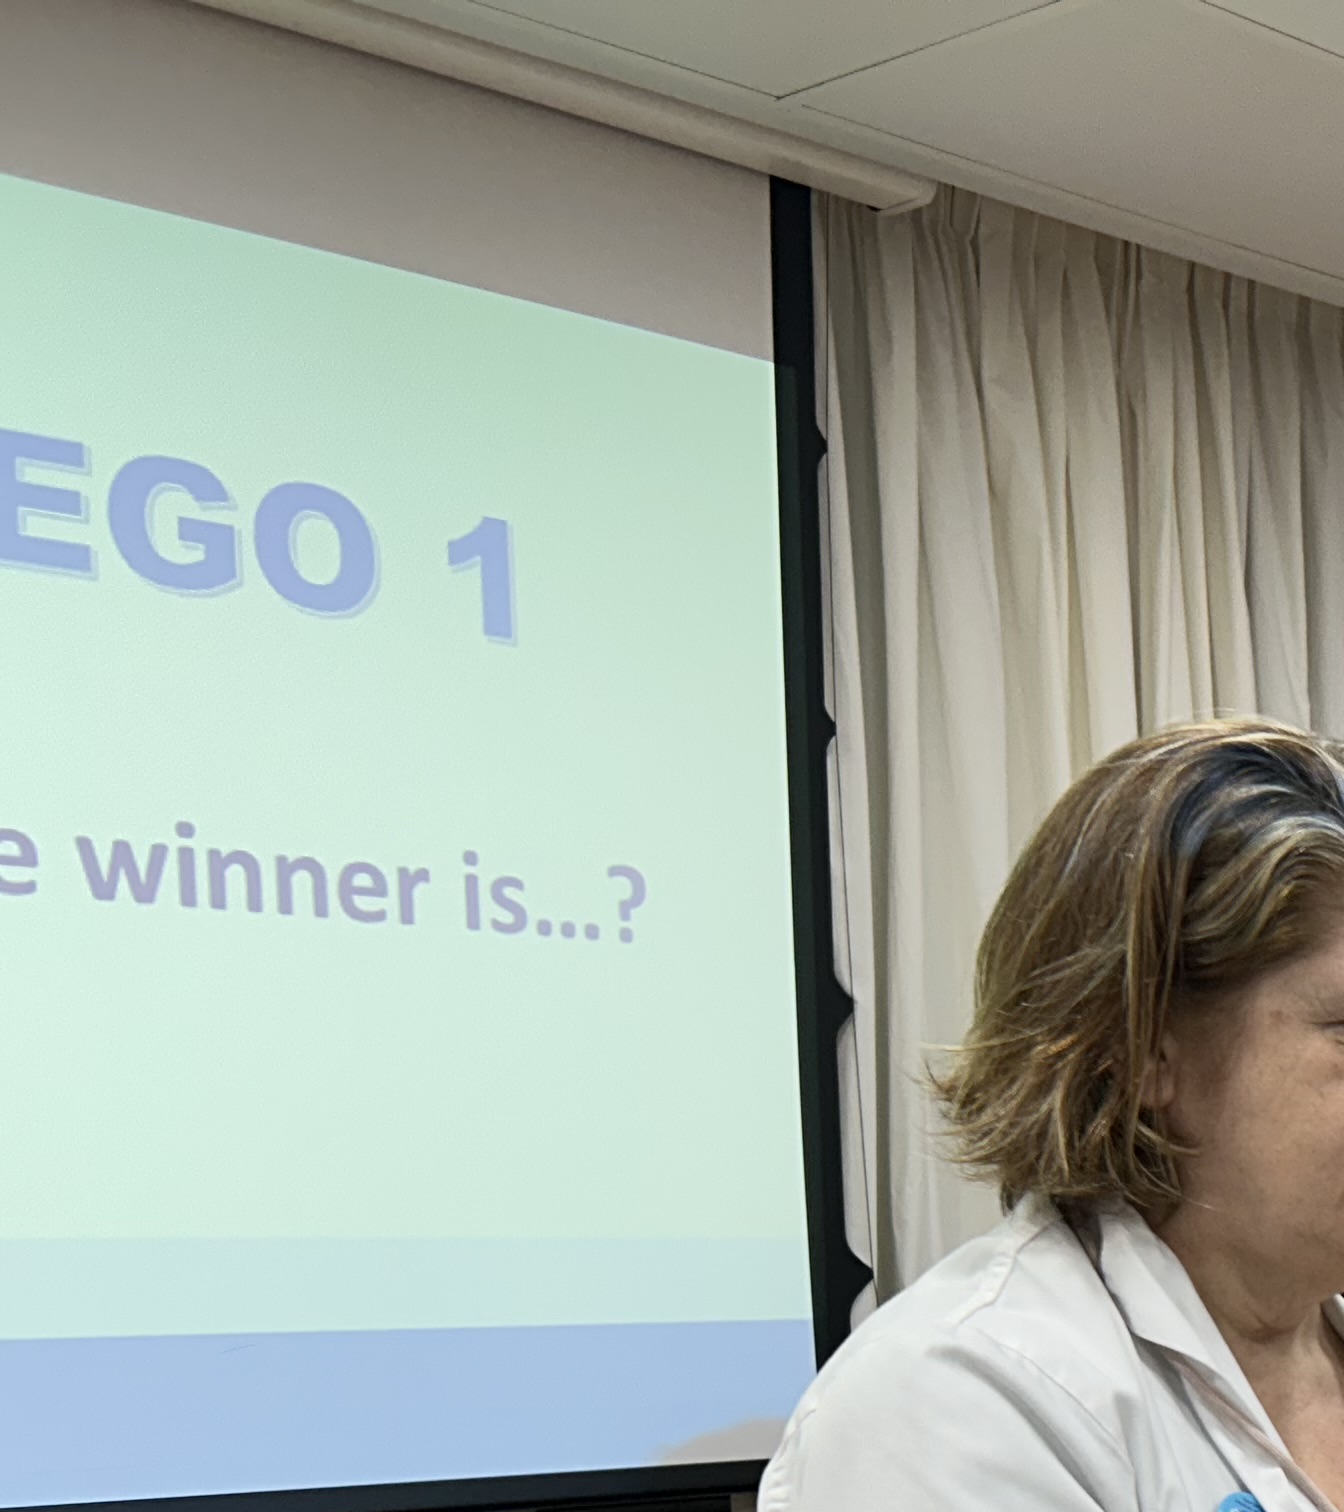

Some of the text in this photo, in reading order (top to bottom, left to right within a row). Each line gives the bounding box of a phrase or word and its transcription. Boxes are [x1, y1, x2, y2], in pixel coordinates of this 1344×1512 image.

[0, 428, 518, 646] EGO 1
[75, 820, 431, 926] winner
[462, 849, 648, 944] is...?
